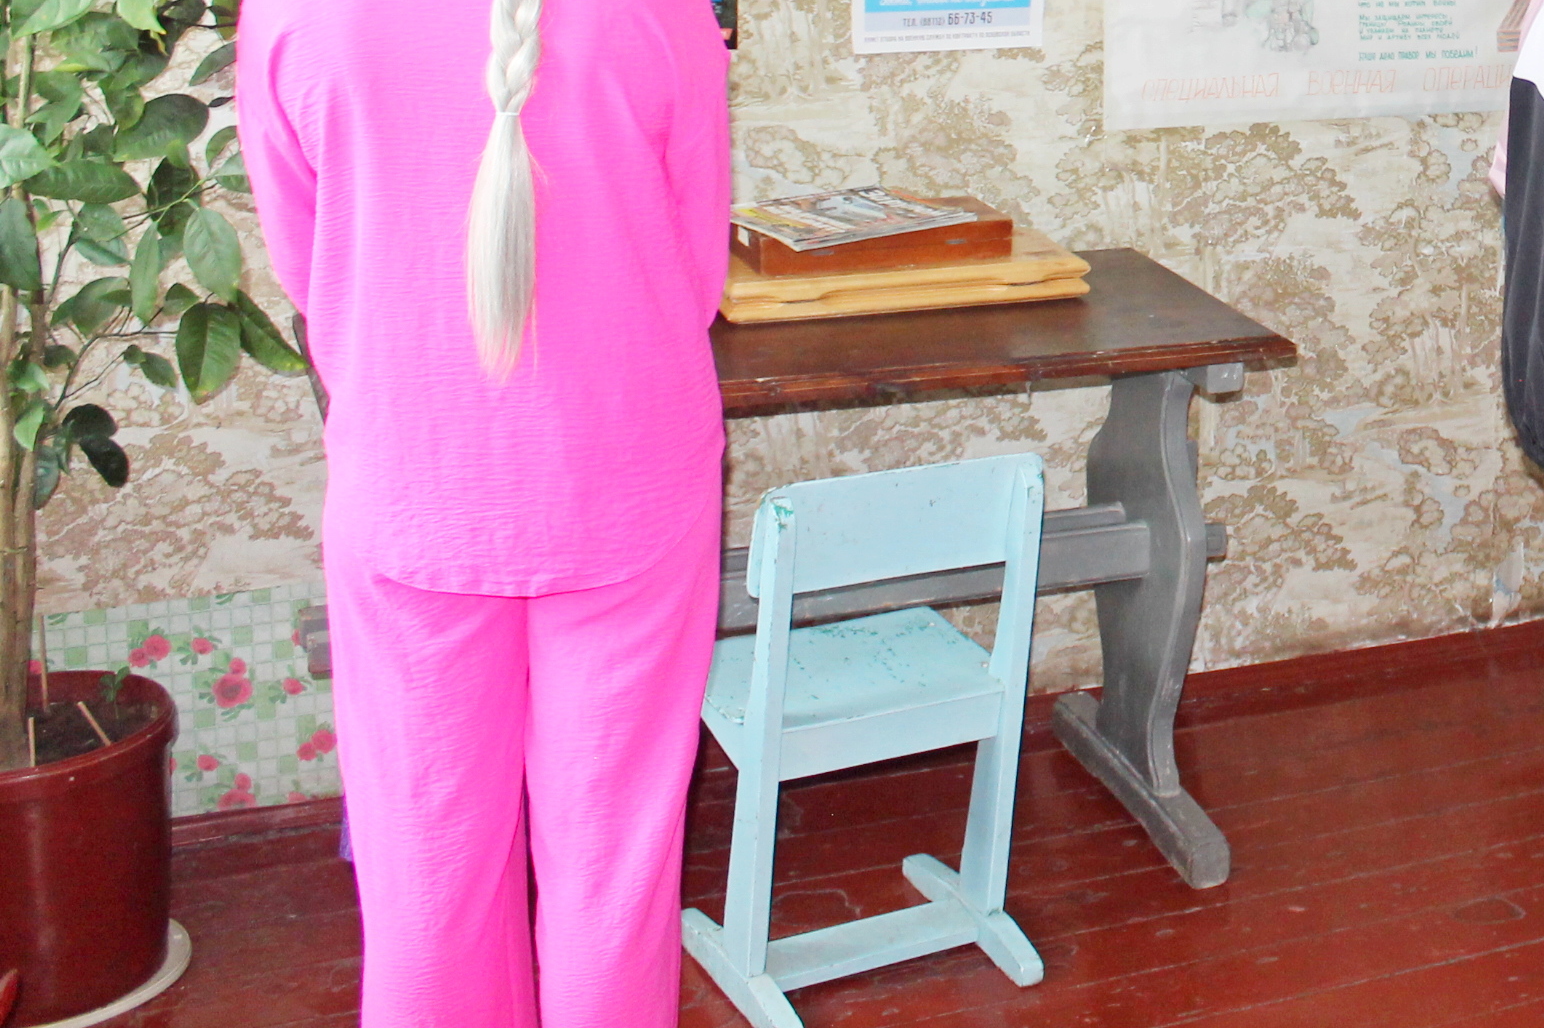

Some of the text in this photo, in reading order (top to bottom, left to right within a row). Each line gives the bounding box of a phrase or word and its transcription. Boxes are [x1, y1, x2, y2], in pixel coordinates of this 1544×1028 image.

[947, 11, 993, 26] 66-73-45
[1141, 64, 1513, 104] СПЕЦИАЛЬНАЯ ВОЕННАЯ ОПЕРАЦИ
